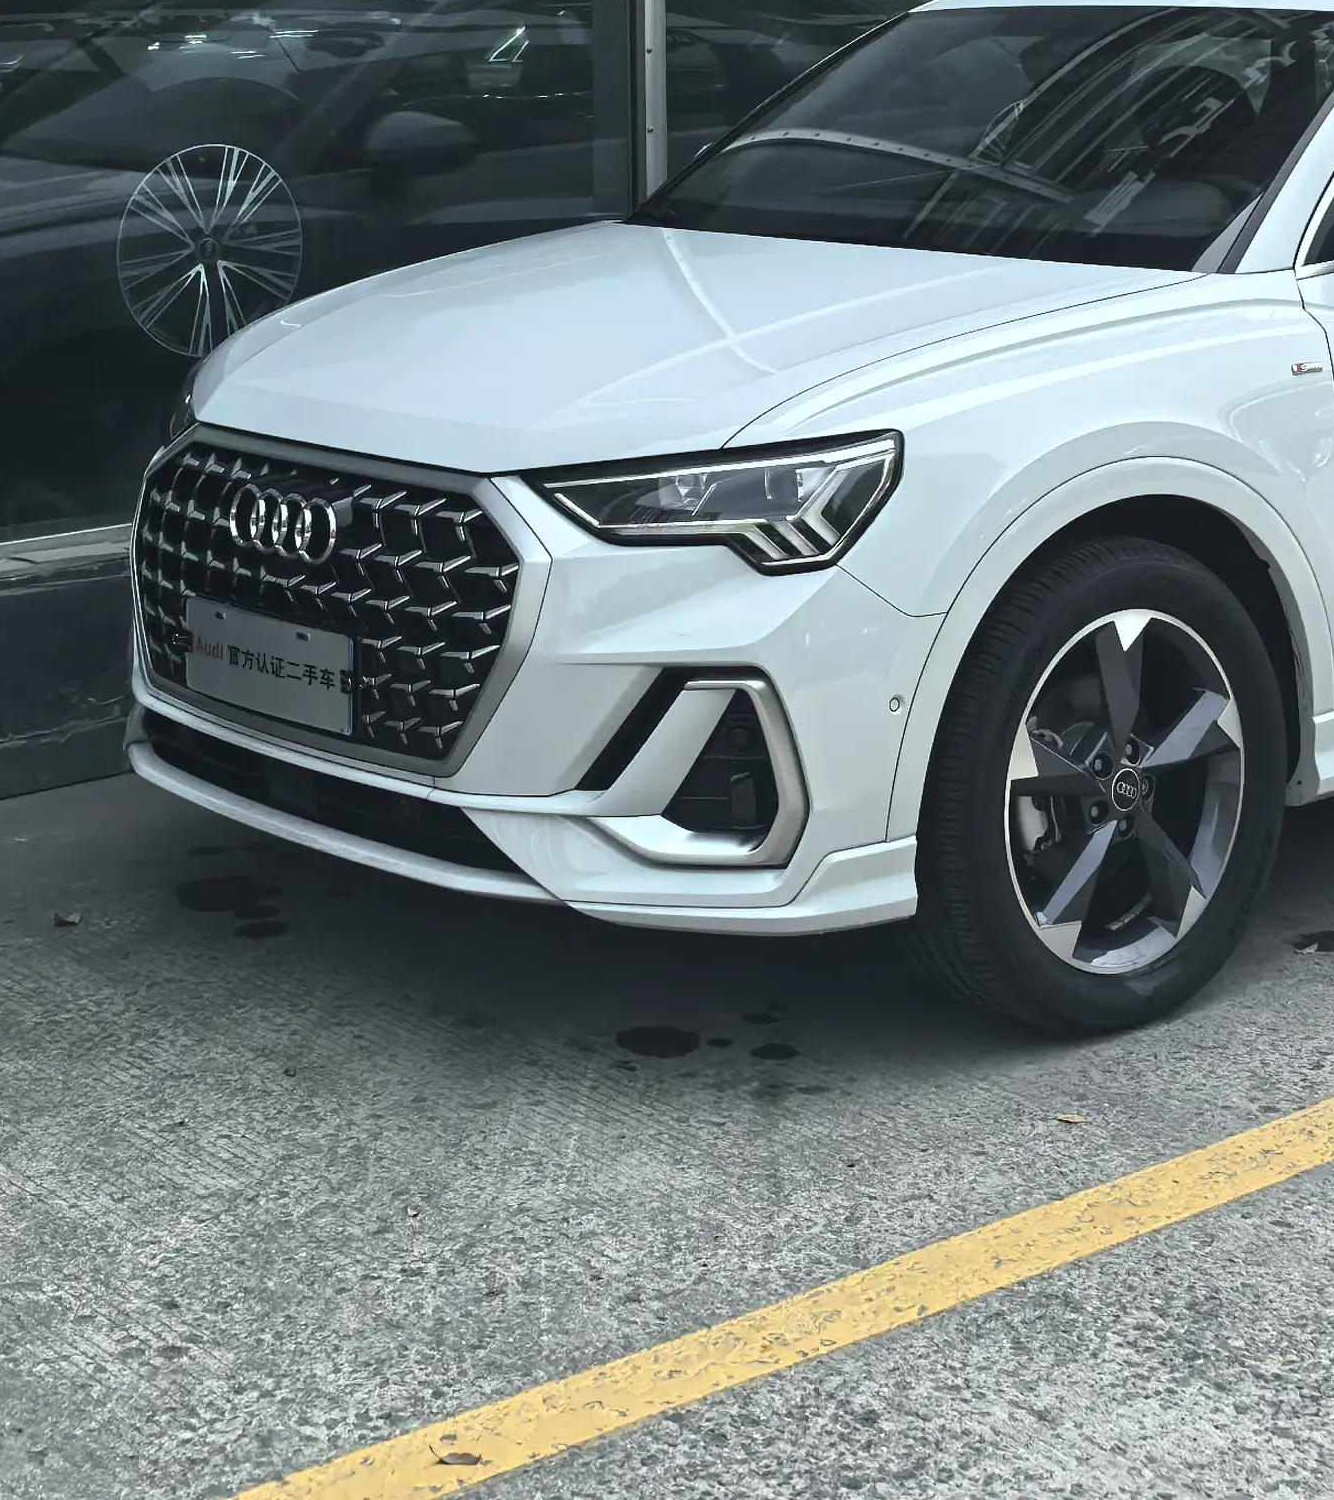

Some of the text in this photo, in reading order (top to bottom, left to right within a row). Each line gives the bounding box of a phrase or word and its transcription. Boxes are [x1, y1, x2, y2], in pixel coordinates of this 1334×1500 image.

[196, 632, 335, 690] Audi 官方认证二手车
